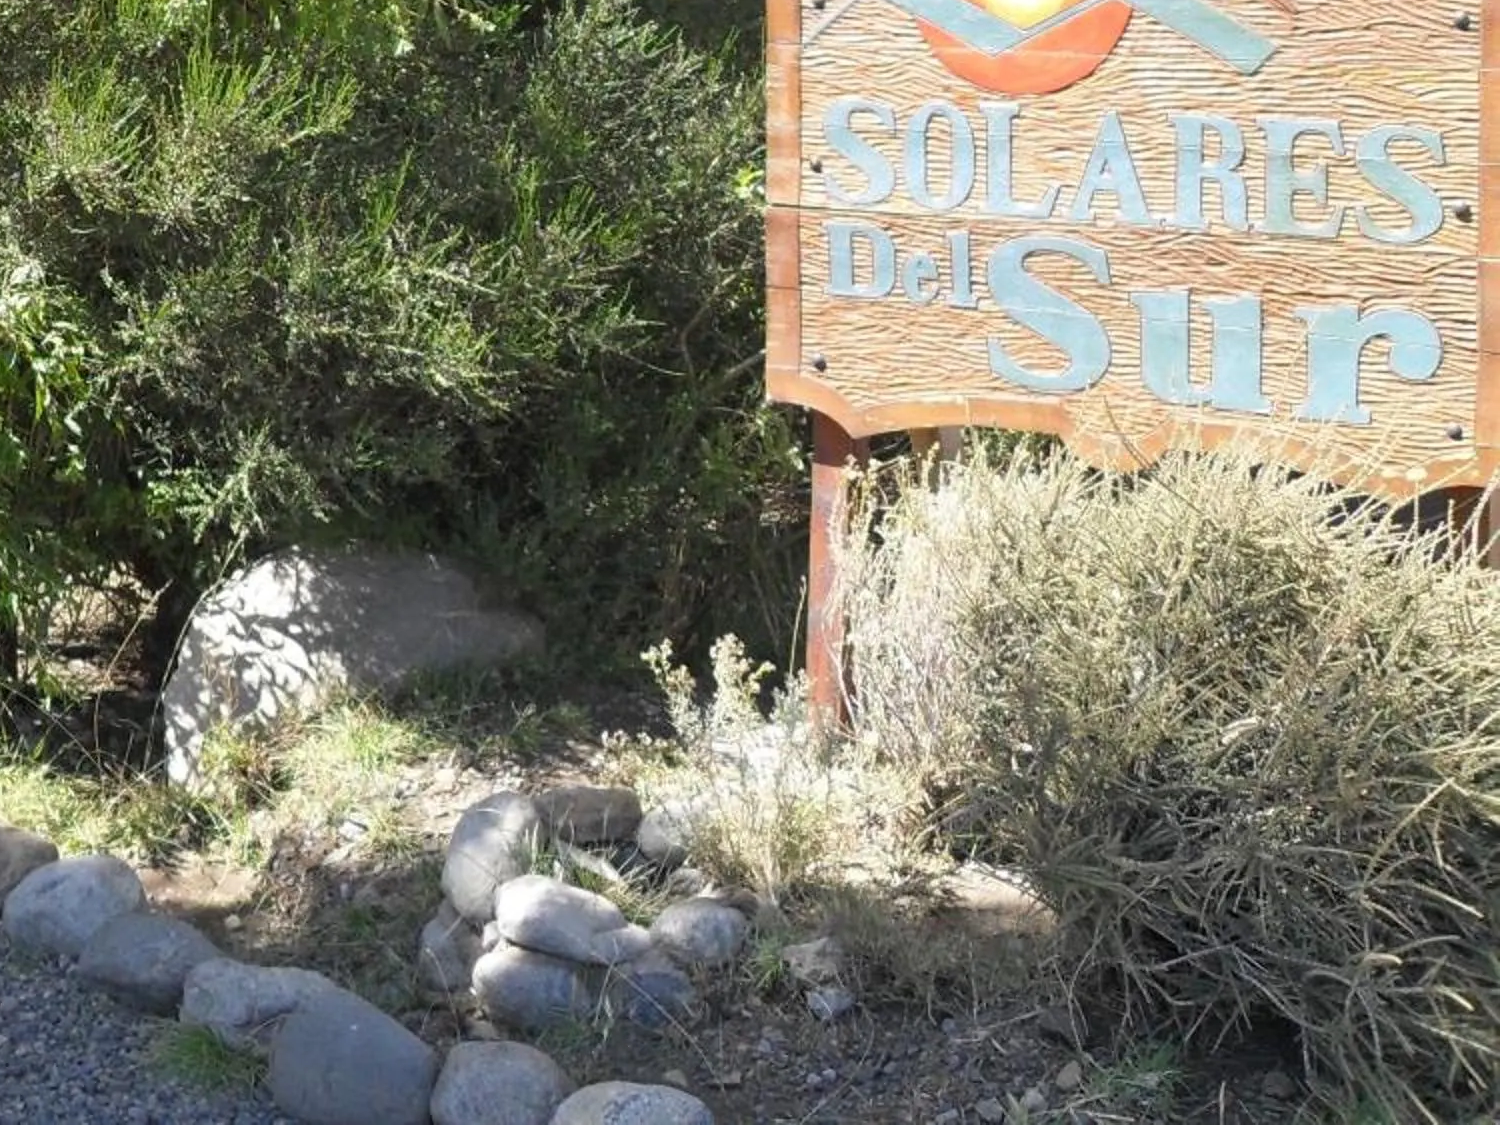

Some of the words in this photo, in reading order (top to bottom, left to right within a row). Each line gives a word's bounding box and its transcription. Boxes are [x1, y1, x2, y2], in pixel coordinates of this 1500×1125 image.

[822, 98, 1447, 244] SOLARES
[824, 220, 979, 310] Del
[987, 234, 1444, 425] Sur
